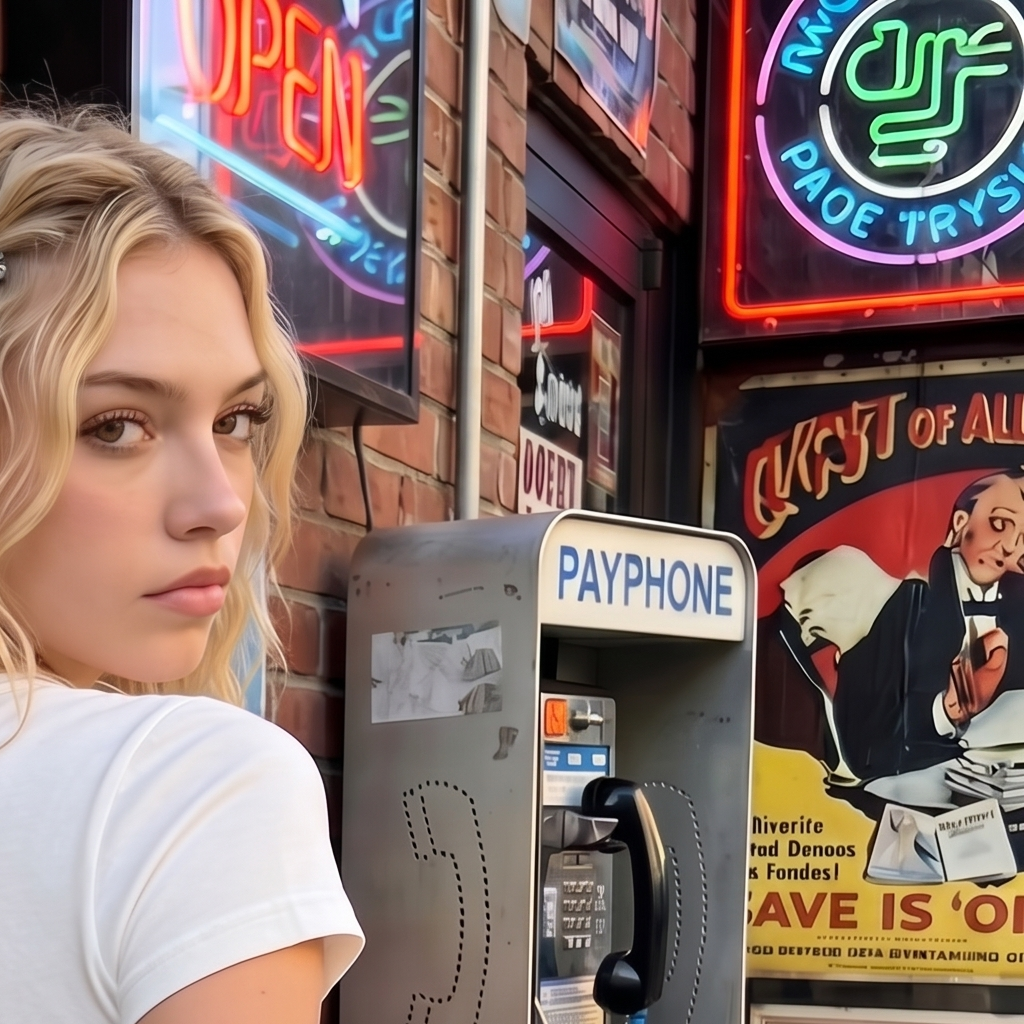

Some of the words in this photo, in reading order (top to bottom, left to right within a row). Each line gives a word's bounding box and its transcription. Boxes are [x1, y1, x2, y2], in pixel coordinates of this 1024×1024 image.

[175, 0, 364, 190] OPEN
[907, 404, 956, 449] OF
[558, 545, 733, 616] PAYPHONE
[788, 839, 856, 857] Denoos
[767, 862, 839, 880] Fondes!
[747, 890, 858, 930] AVE
[882, 892, 933, 931] IS
